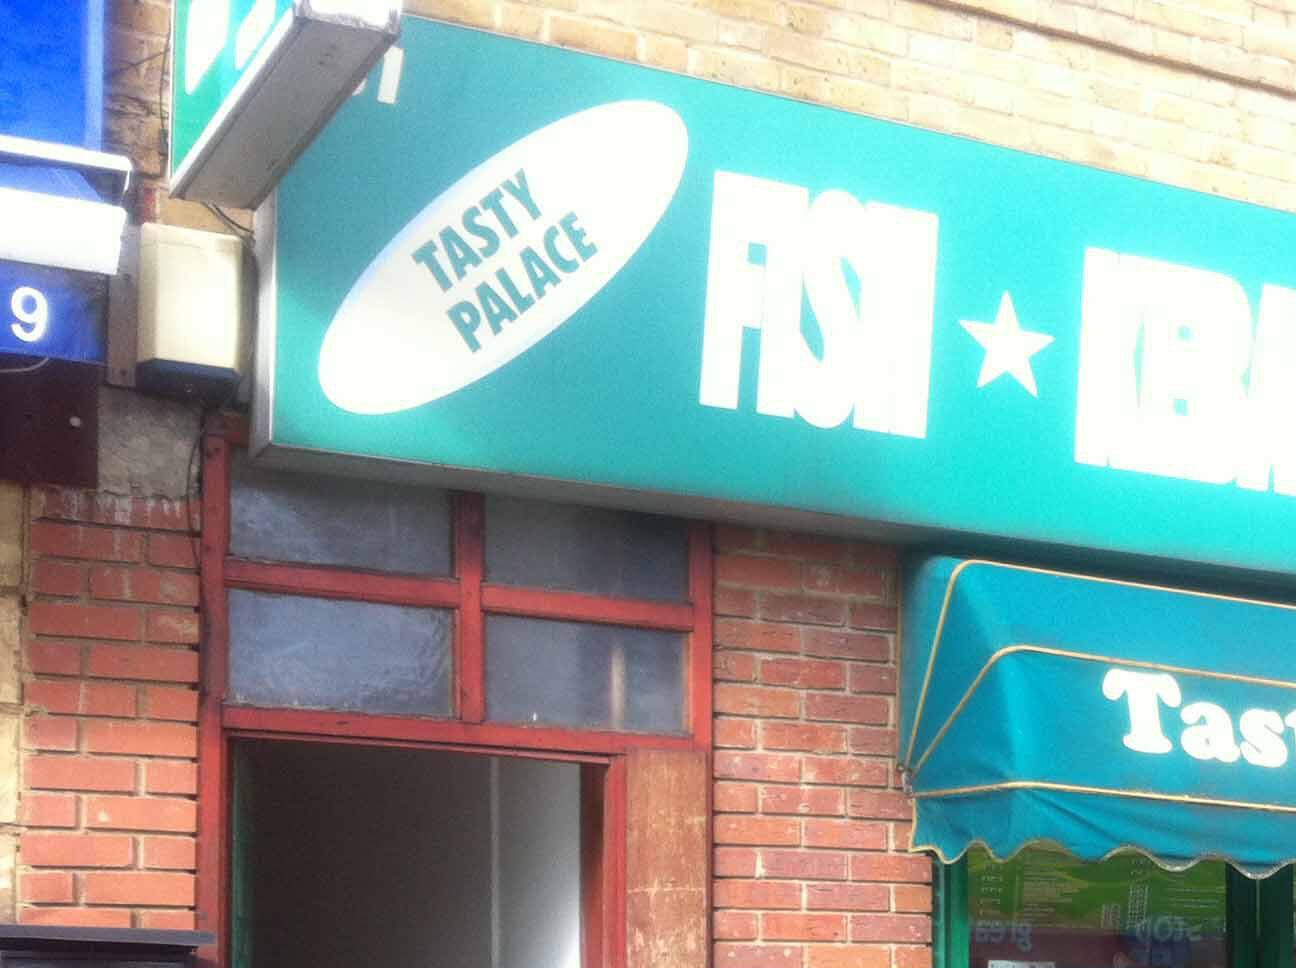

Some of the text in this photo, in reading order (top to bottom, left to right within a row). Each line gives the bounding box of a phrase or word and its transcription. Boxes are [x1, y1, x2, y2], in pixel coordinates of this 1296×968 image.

[411, 167, 542, 293] TASTY
[445, 211, 599, 354] PALACE
[11, 286, 49, 343] 9
[699, 170, 939, 439] FISH
